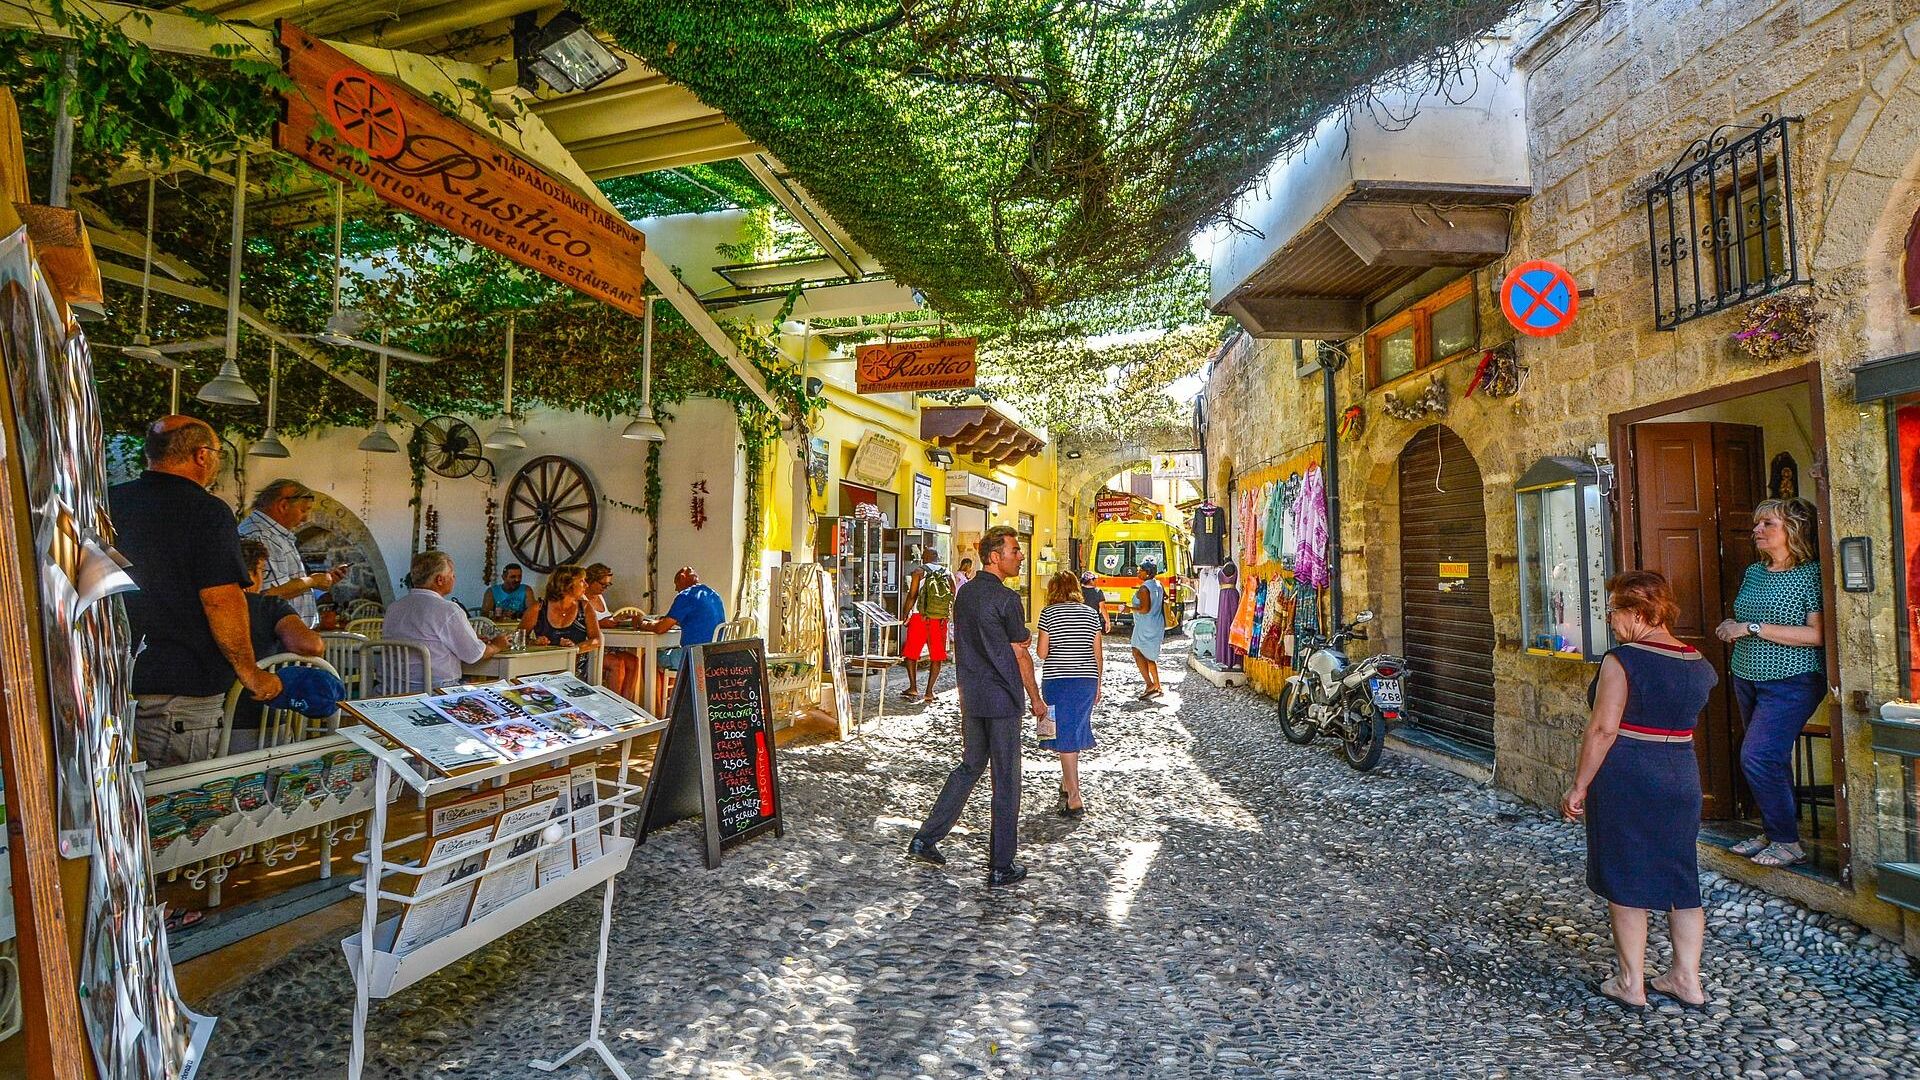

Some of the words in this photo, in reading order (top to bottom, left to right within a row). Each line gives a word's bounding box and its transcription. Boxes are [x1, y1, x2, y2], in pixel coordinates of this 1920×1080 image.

[304, 134, 459, 220] TRADITIONAL
[380, 133, 592, 258] Rustico
[498, 153, 589, 218] ΠΑΡΑΔΟΣΙΑΚΗ
[591, 207, 638, 244] ΤΑΒΕΡΝΑ
[880, 349, 971, 380] Rustico
[1379, 681, 1398, 690] PKP
[710, 690, 748, 701] MUSIC
[1381, 692, 1401, 701] 268
[709, 711, 736, 721] SPECIAL
[737, 708, 753, 718] OFFER
[714, 721, 736, 733] BEER
[717, 740, 743, 750] FRESH
[713, 748, 747, 760] ORANGE
[719, 771, 734, 781] ICE
[722, 802, 742, 816] FREE
[735, 809, 758, 822] SCREEN
